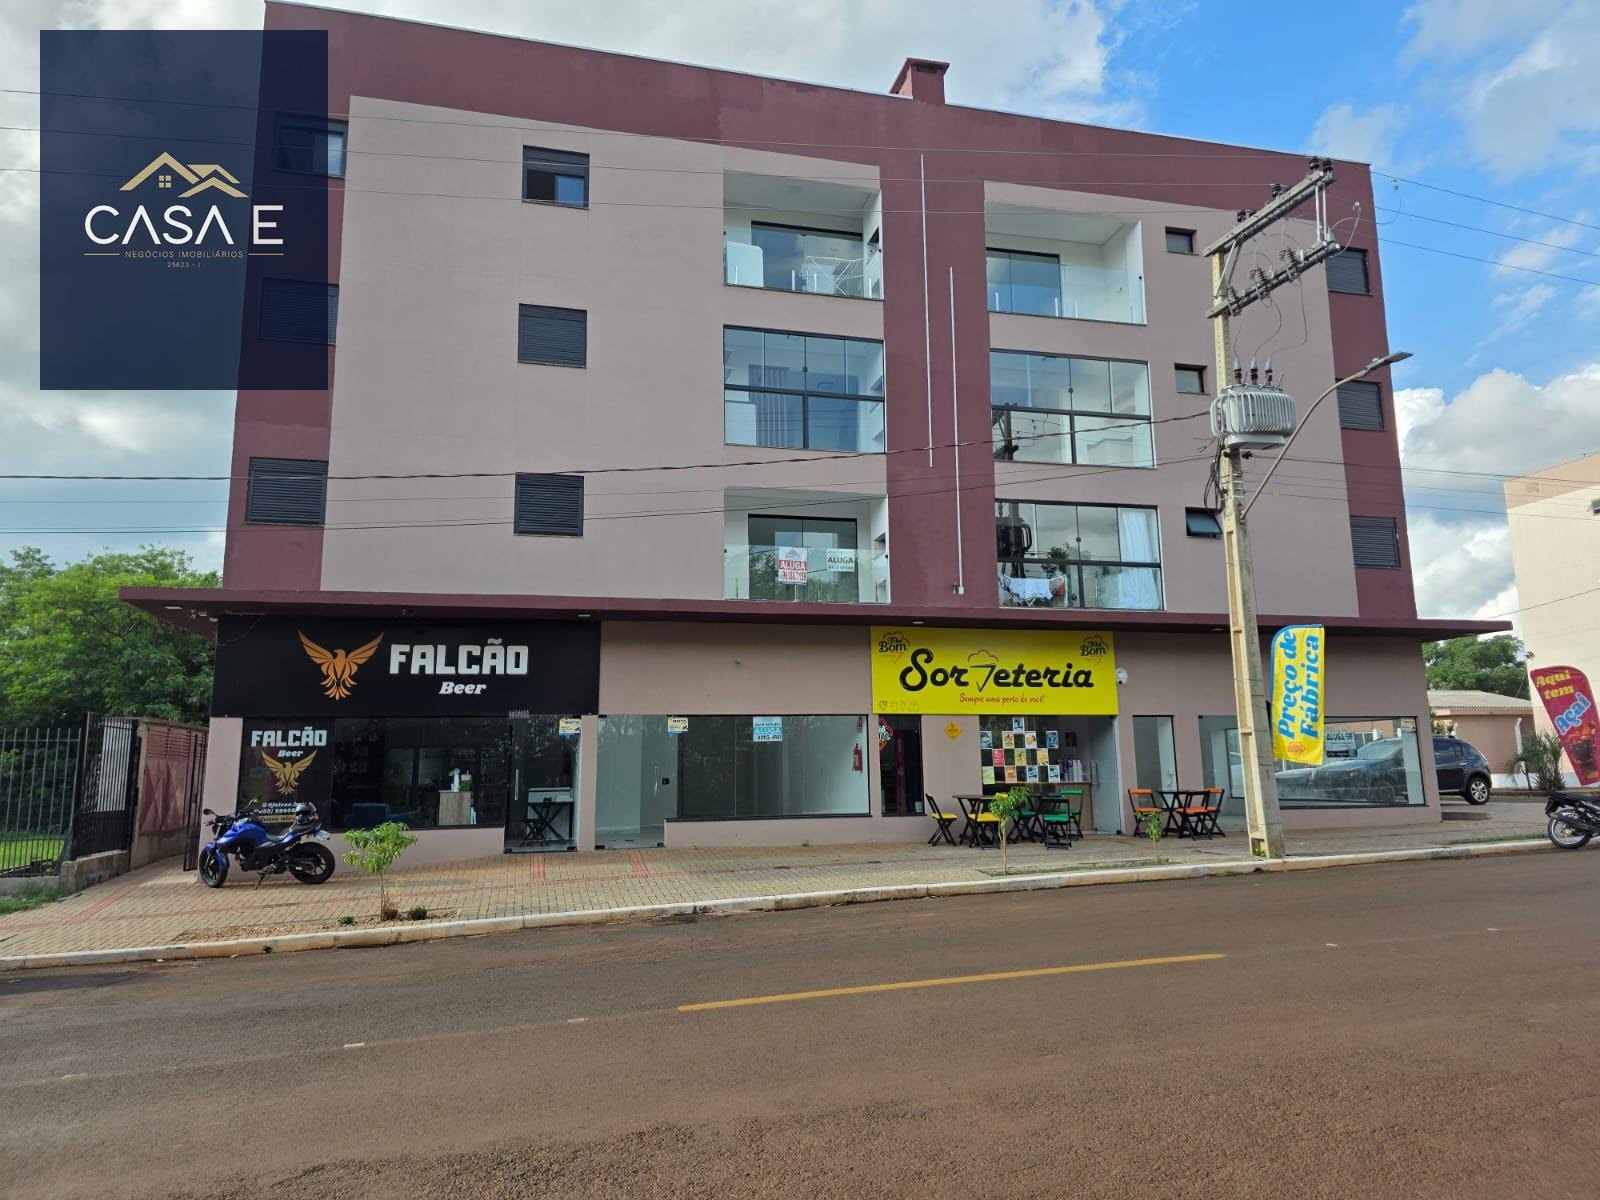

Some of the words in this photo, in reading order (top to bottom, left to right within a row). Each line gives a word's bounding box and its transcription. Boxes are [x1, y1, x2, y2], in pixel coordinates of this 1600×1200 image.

[780, 560, 806, 570] ALUGA
[827, 556, 854, 564] ALUGA
[878, 640, 908, 652] Bom
[1080, 645, 1106, 656] Bom
[1280, 629, 1297, 659] de
[389, 637, 529, 675] FALCÃO
[1536, 669, 1571, 687] Aqui
[439, 681, 487, 694] Beer
[1300, 635, 1319, 738] Fábrica
[1544, 685, 1575, 699] tem
[960, 692, 984, 708] Sempre
[1002, 694, 1019, 708] perto
[1020, 692, 1028, 703] de
[1278, 664, 1303, 739] Preço
[251, 726, 327, 747] FALCÃO
[277, 749, 304, 757] Beer
